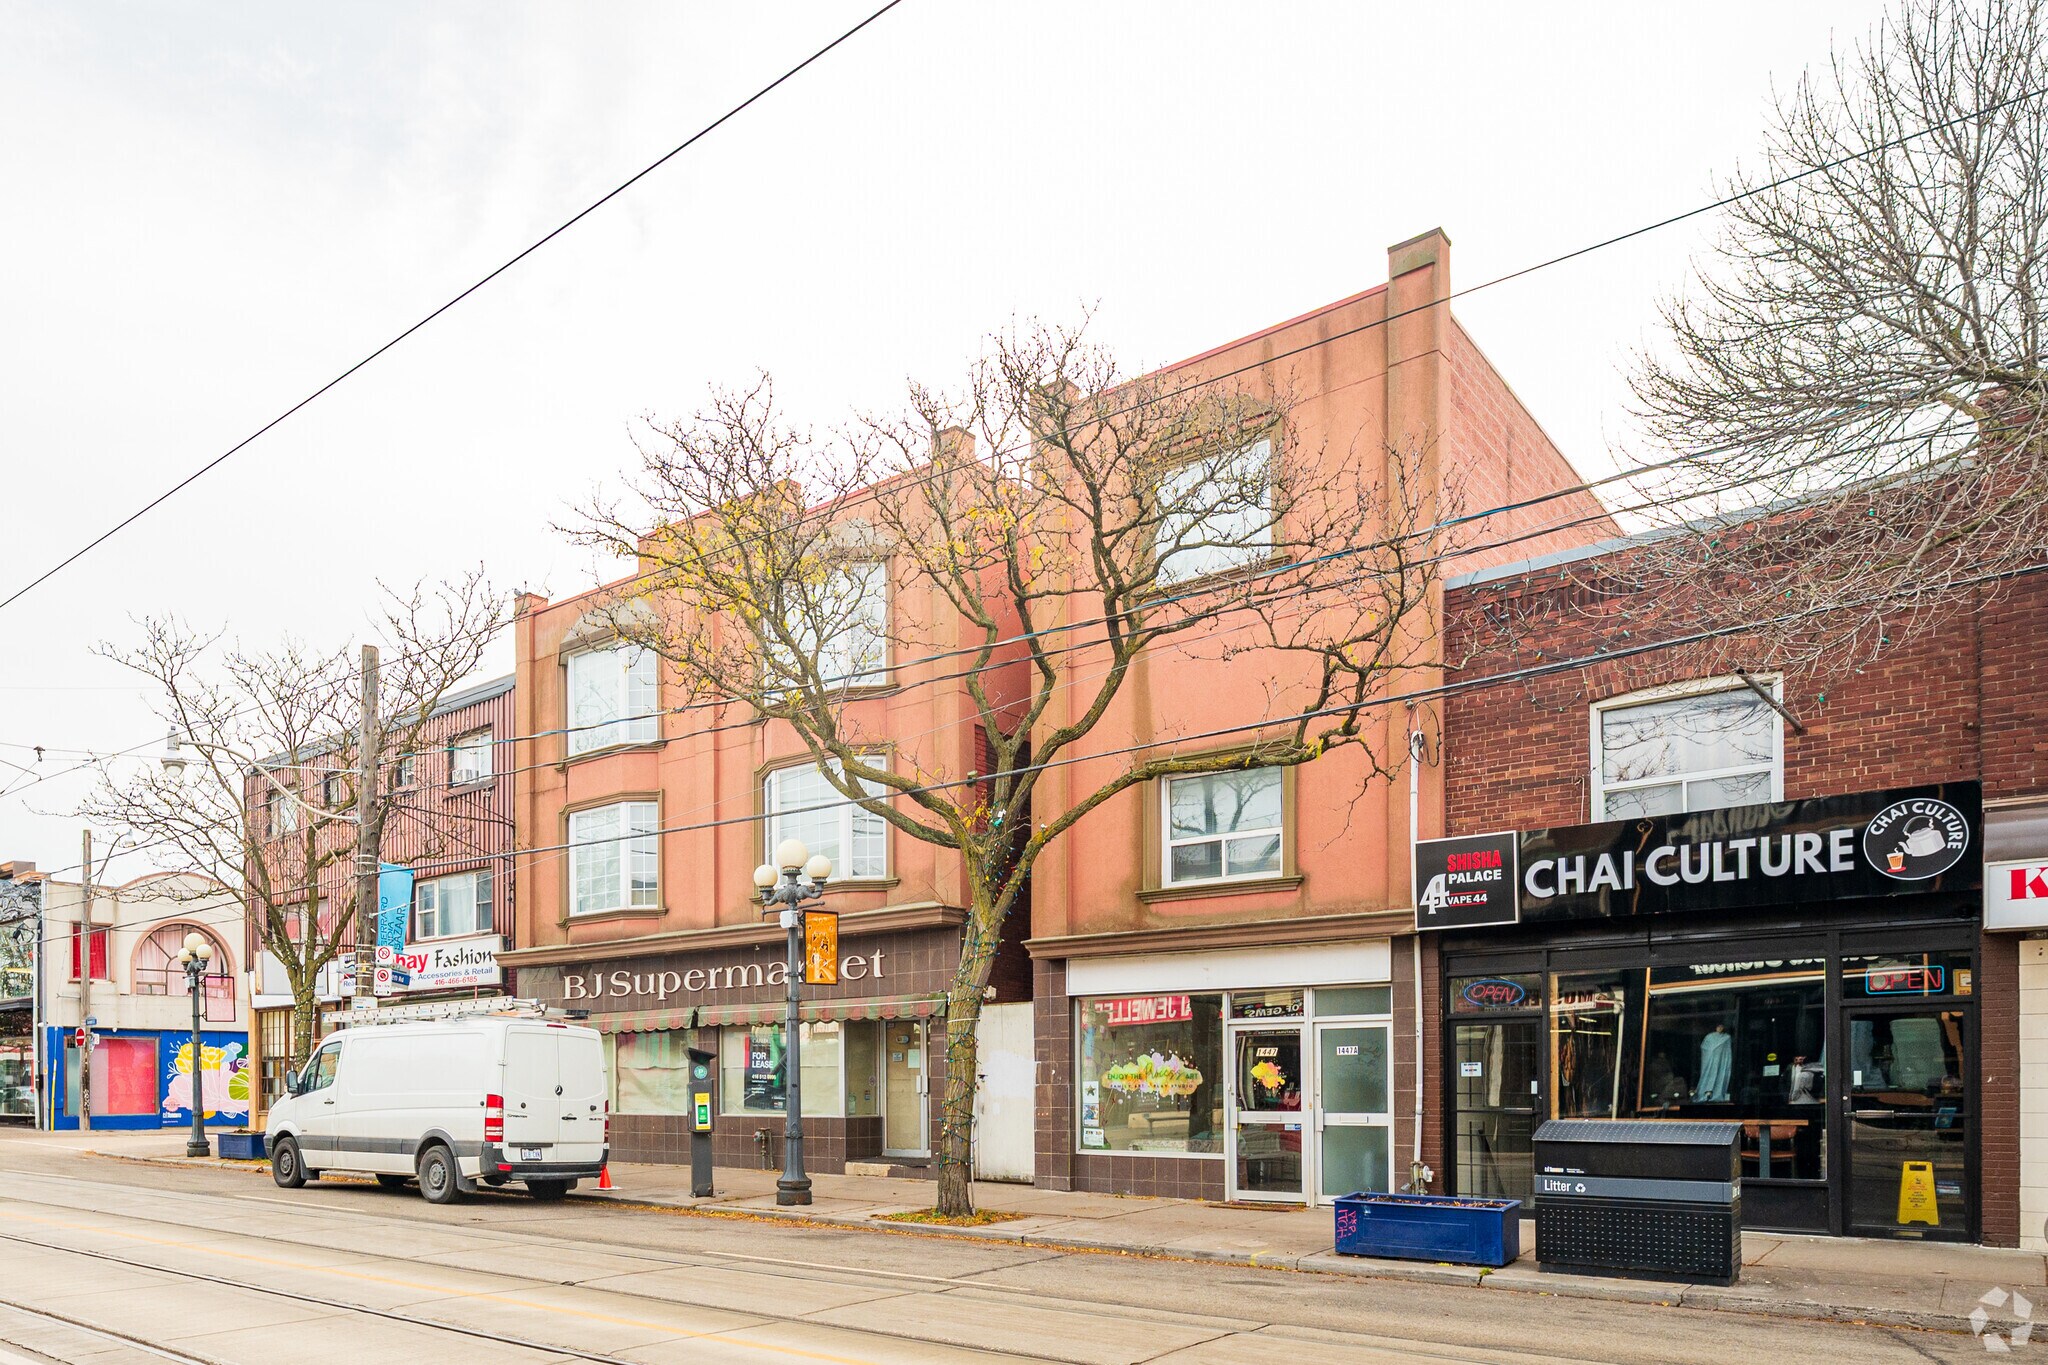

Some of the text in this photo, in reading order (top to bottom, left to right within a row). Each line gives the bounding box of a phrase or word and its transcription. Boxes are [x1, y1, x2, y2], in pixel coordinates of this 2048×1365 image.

[1870, 801, 1964, 850] CHAI CULTURE
[1447, 849, 1502, 872] SHISHA
[1524, 828, 1855, 898] CHAI CULTURE
[1448, 868, 1502, 885] PALACE
[1447, 893, 1488, 905] VAPE 44
[395, 947, 493, 974] bay Fashion
[417, 971, 463, 980] Accessories
[471, 966, 493, 975] Retail
[1869, 968, 1941, 991] OPEN
[434, 976, 478, 986] 416-466-6185
[562, 972, 603, 1001] BJ
[1471, 984, 1517, 1002] OPEN
[751, 1052, 767, 1060] FOR
[1257, 1048, 1277, 1056] 1447
[1337, 1046, 1358, 1054] 1447A
[751, 1060, 774, 1069] LEASE
[1544, 1178, 1572, 1192] Litter
